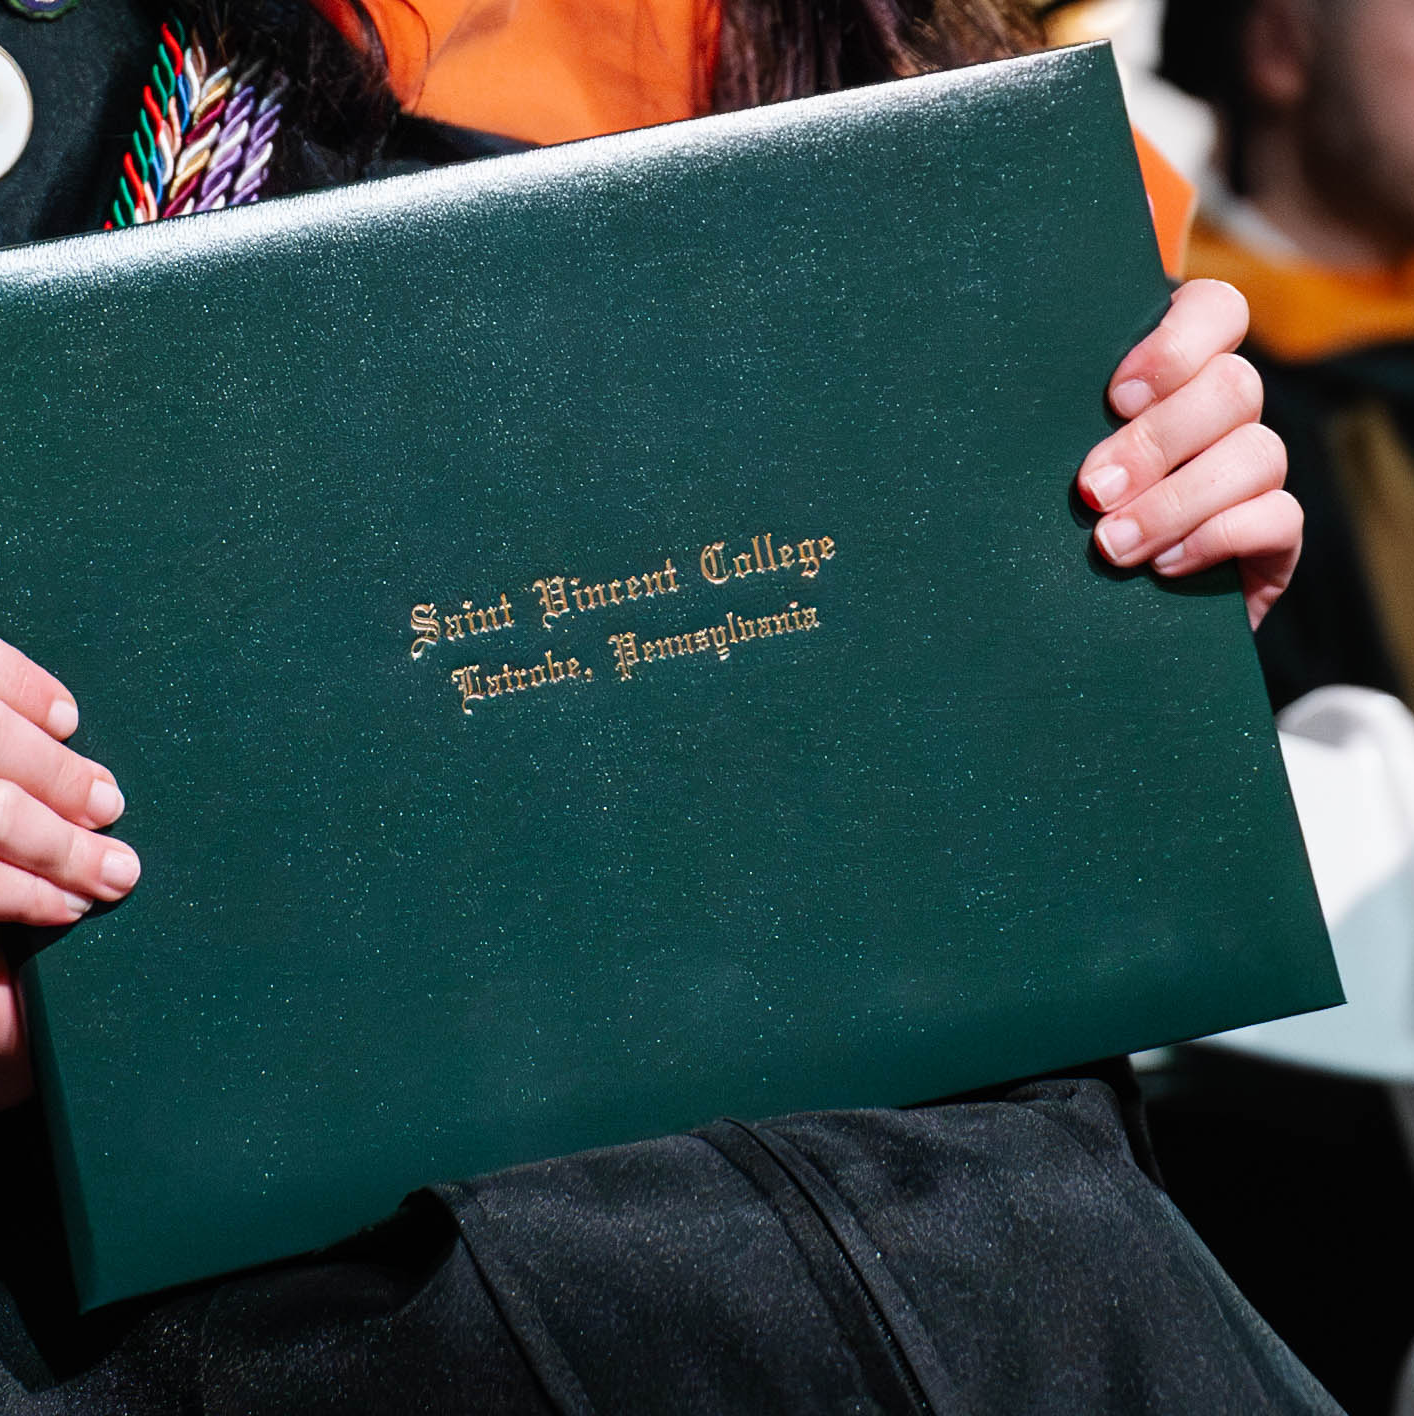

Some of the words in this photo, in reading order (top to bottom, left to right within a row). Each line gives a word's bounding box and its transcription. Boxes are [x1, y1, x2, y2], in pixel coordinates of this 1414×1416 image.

[410, 591, 515, 660] Saint
[531, 558, 680, 628] Vincent
[700, 532, 836, 584] College
[451, 649, 593, 715] Latrobe,
[607, 601, 820, 682] Pennsylvania
